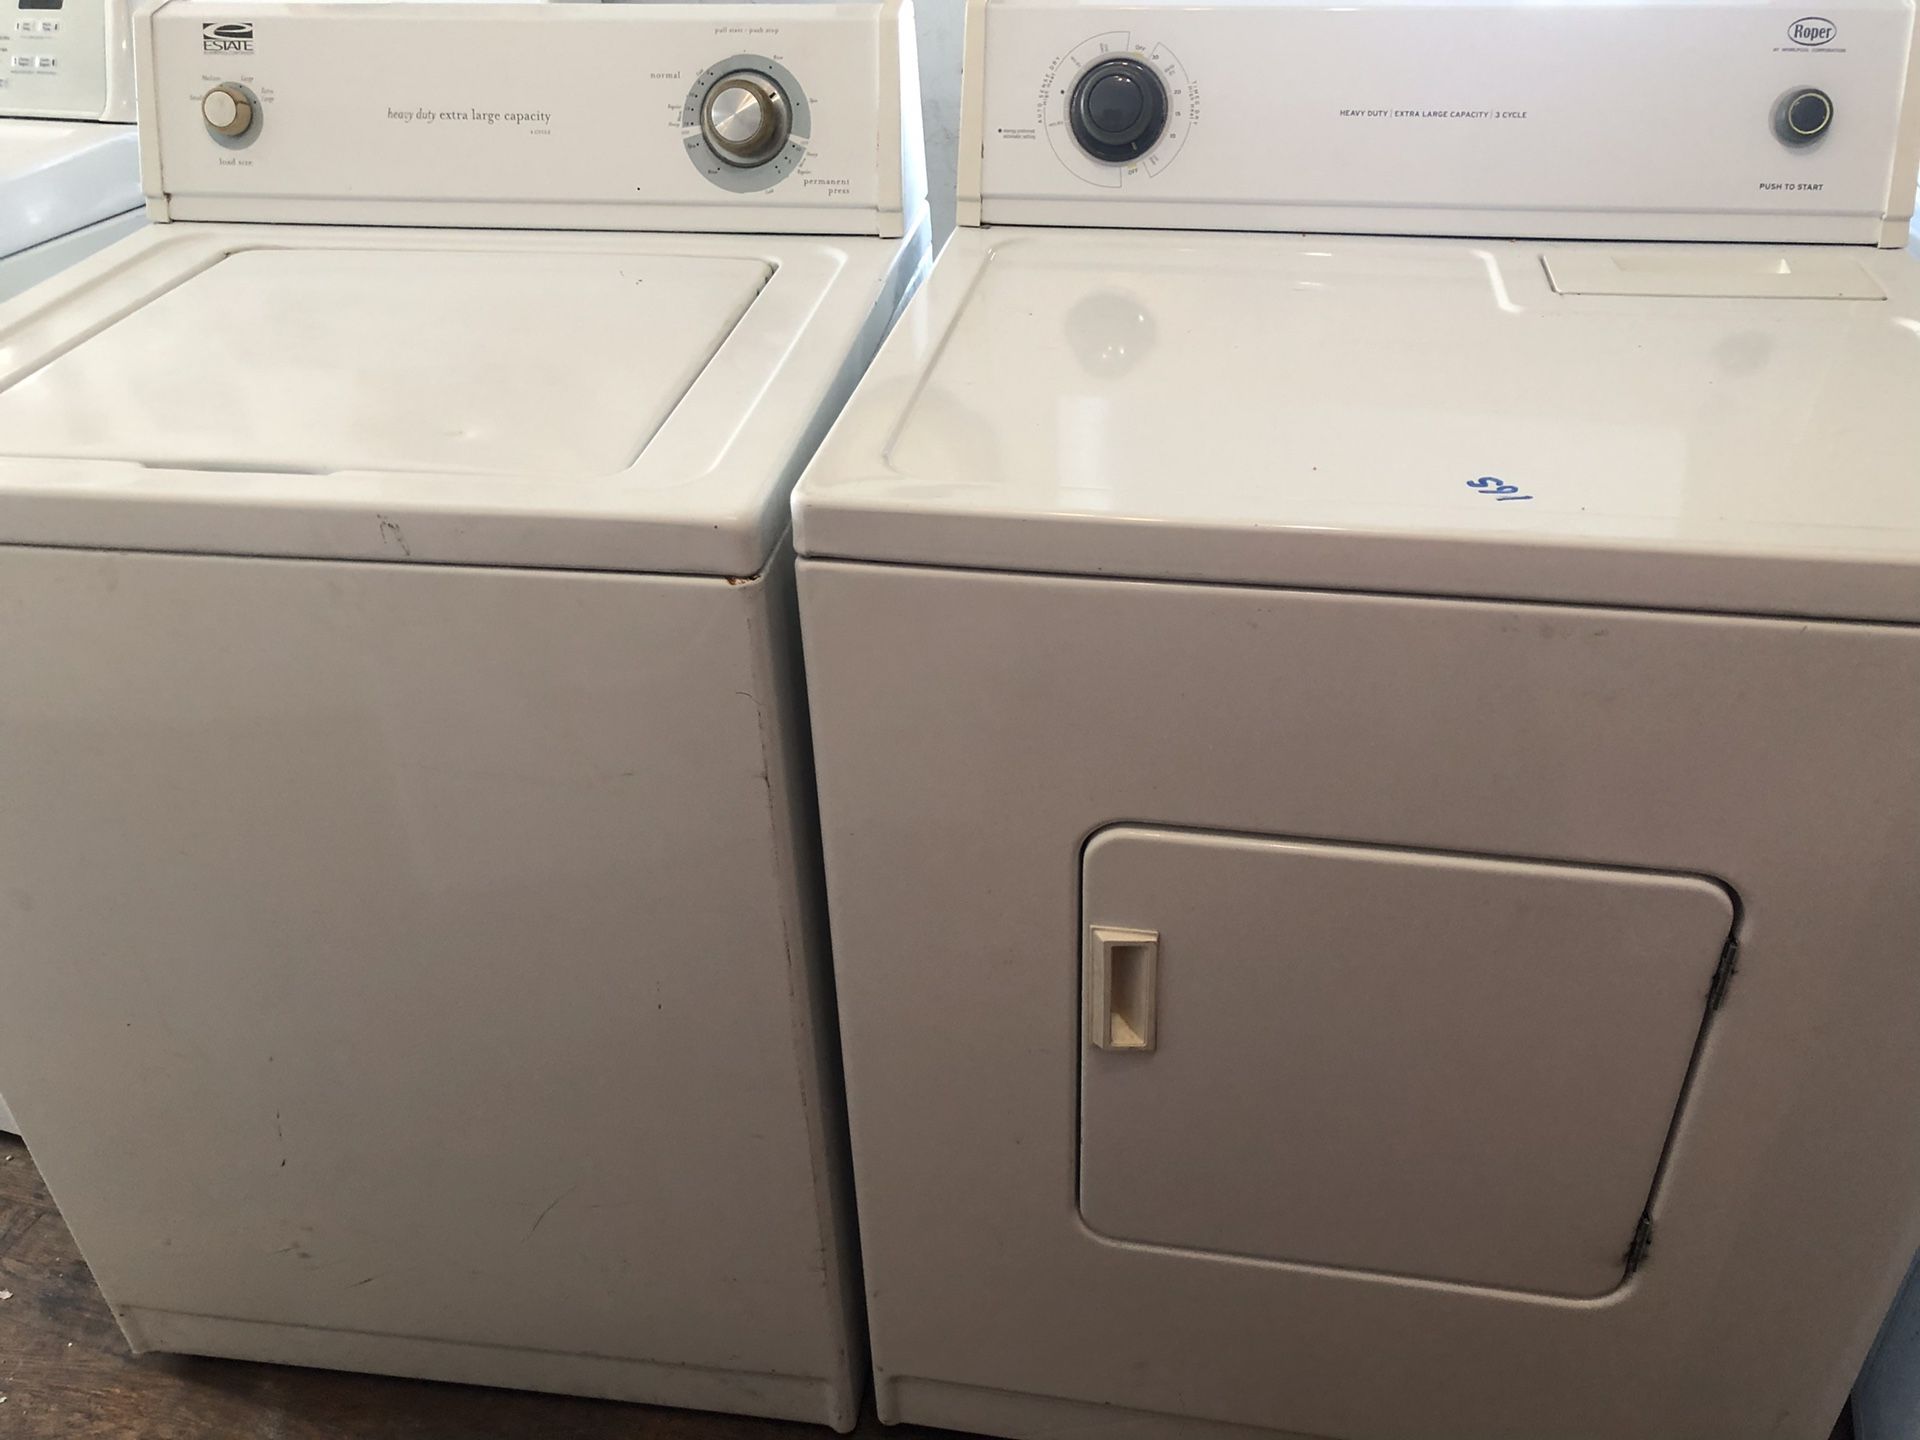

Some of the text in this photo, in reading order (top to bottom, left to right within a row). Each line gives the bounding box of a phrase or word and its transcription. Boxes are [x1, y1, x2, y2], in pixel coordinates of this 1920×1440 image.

[1794, 24, 1833, 41] Roper
[203, 40, 254, 51] ESTATE
[650, 71, 681, 79] normal
[387, 107, 552, 125] heavy duty extra large capacity
[1394, 110, 1420, 118] EXTRA
[1502, 111, 1528, 119] CYCLE
[219, 157, 253, 166] load size
[803, 178, 850, 187] permanent
[828, 188, 850, 196] press
